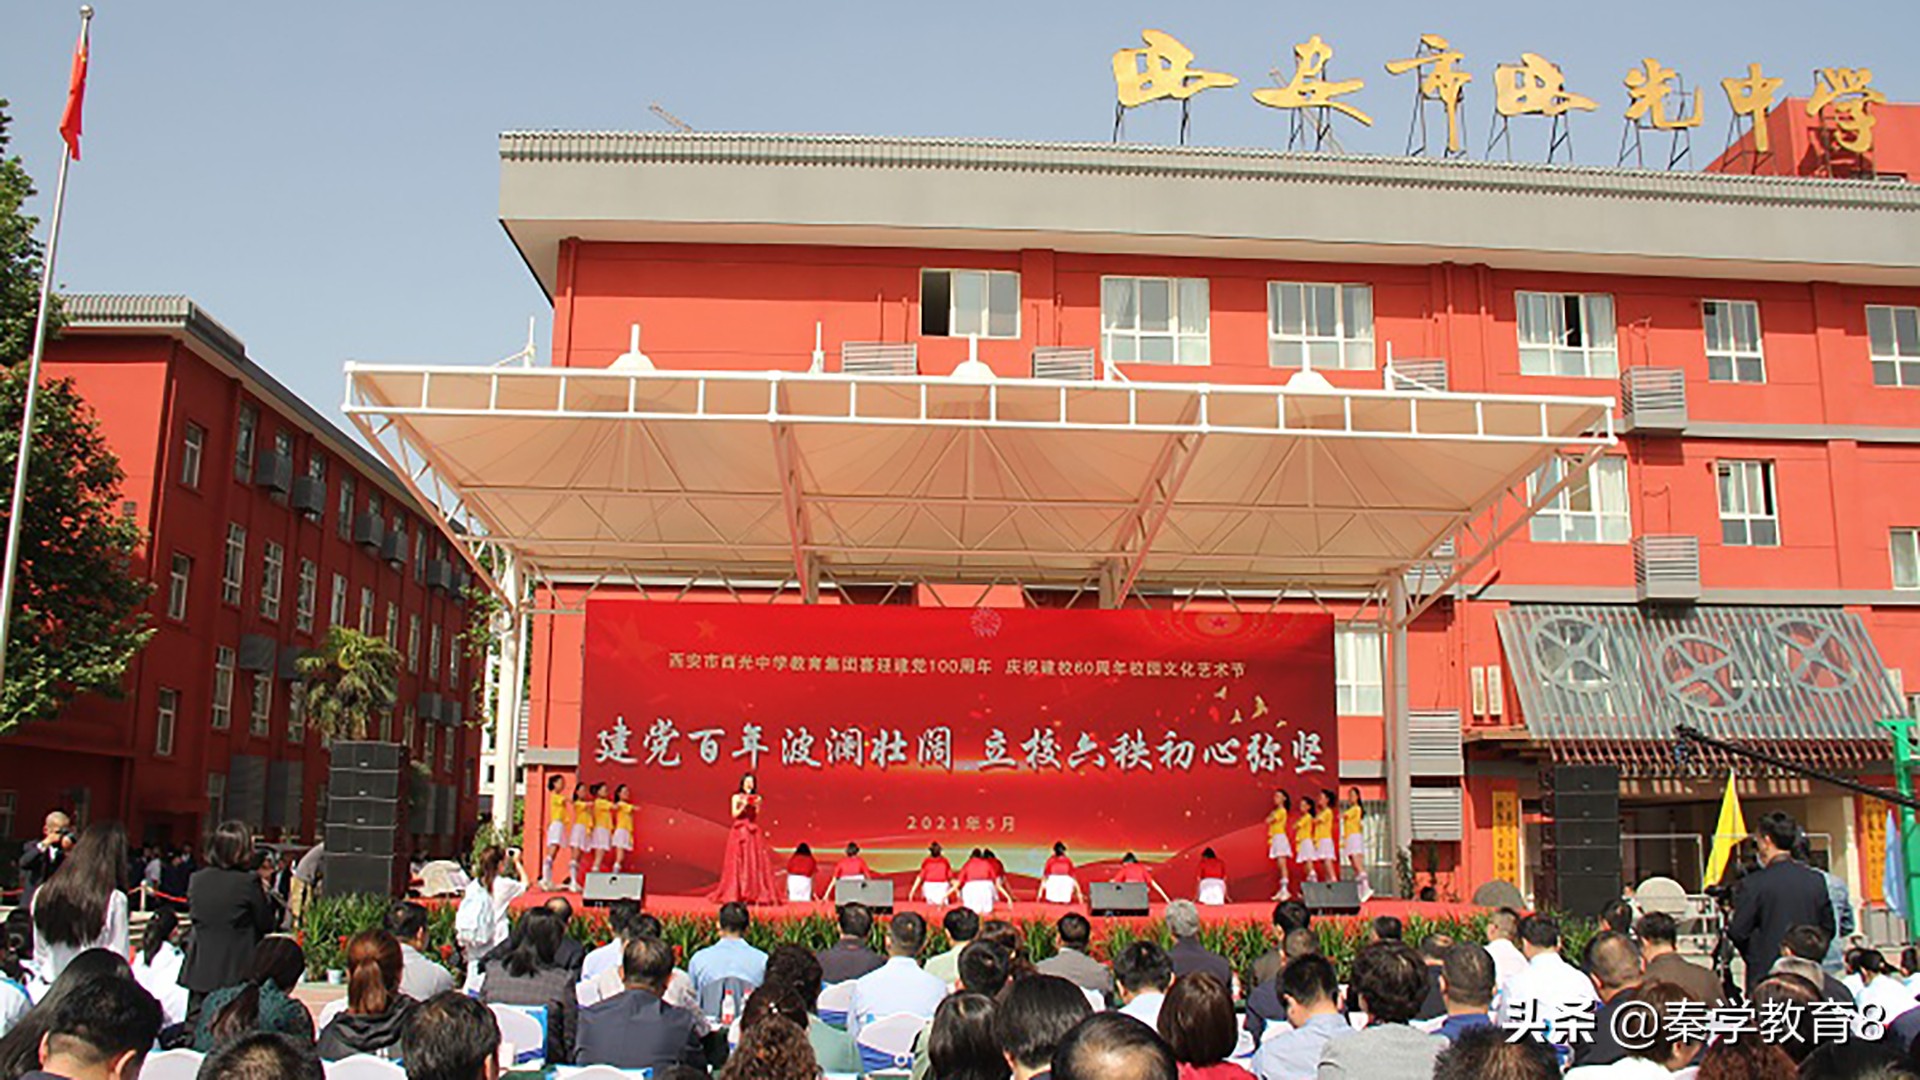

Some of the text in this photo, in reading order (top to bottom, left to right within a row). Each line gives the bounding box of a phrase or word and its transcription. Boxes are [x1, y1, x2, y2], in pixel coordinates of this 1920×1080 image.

[1112, 29, 1887, 153] 西安市西光中学
[1005, 658, 1246, 678] 庆祝建校60周年校园文化艺术节
[594, 716, 1327, 774] 建党百年波澜壮阔 立校六秩初心弥坚
[906, 815, 1016, 833] 2021年5月
